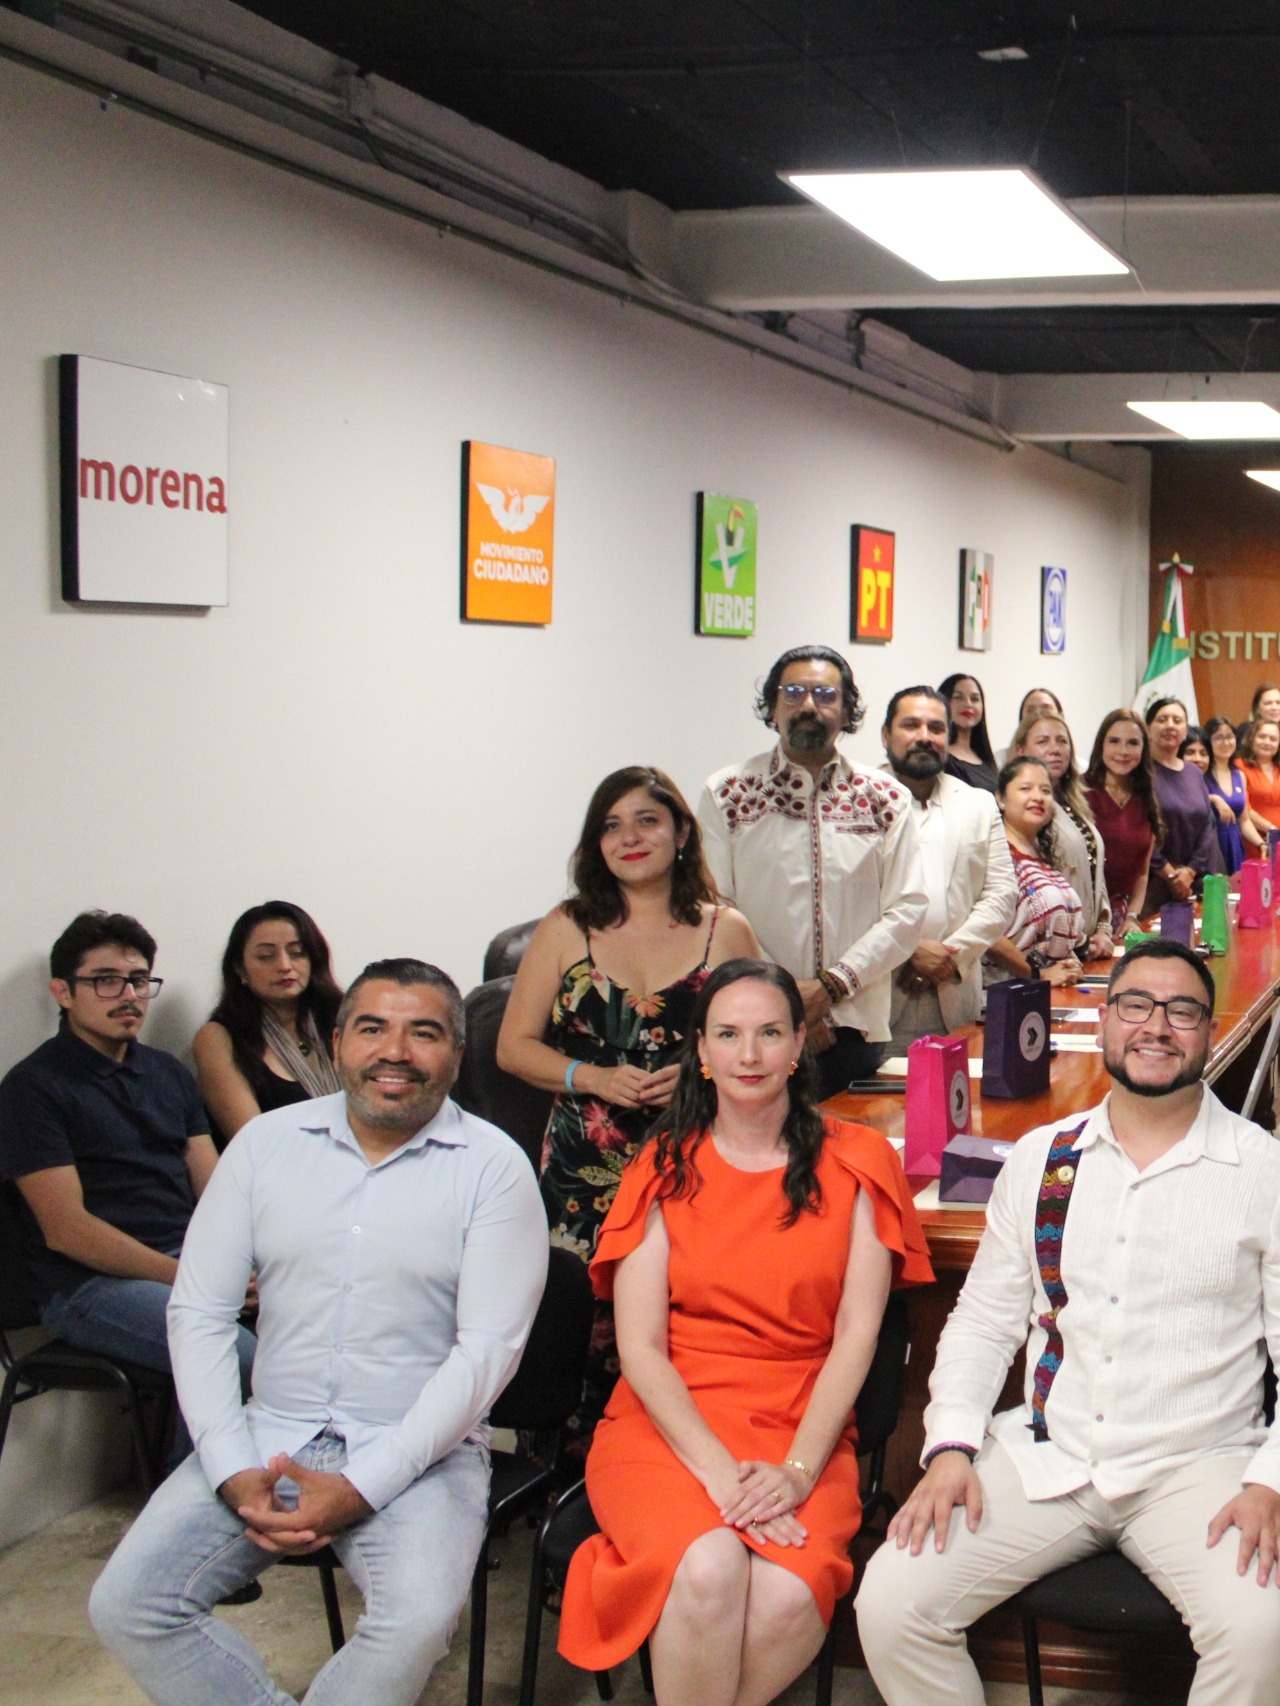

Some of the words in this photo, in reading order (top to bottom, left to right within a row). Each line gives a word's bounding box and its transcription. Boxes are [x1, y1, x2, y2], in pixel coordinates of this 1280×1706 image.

[80, 458, 228, 514] morena
[473, 558, 549, 586] CIUDADANO
[480, 541, 544, 564] MOVIMIENTO
[704, 592, 754, 631] VERDE
[861, 567, 891, 628] PT
